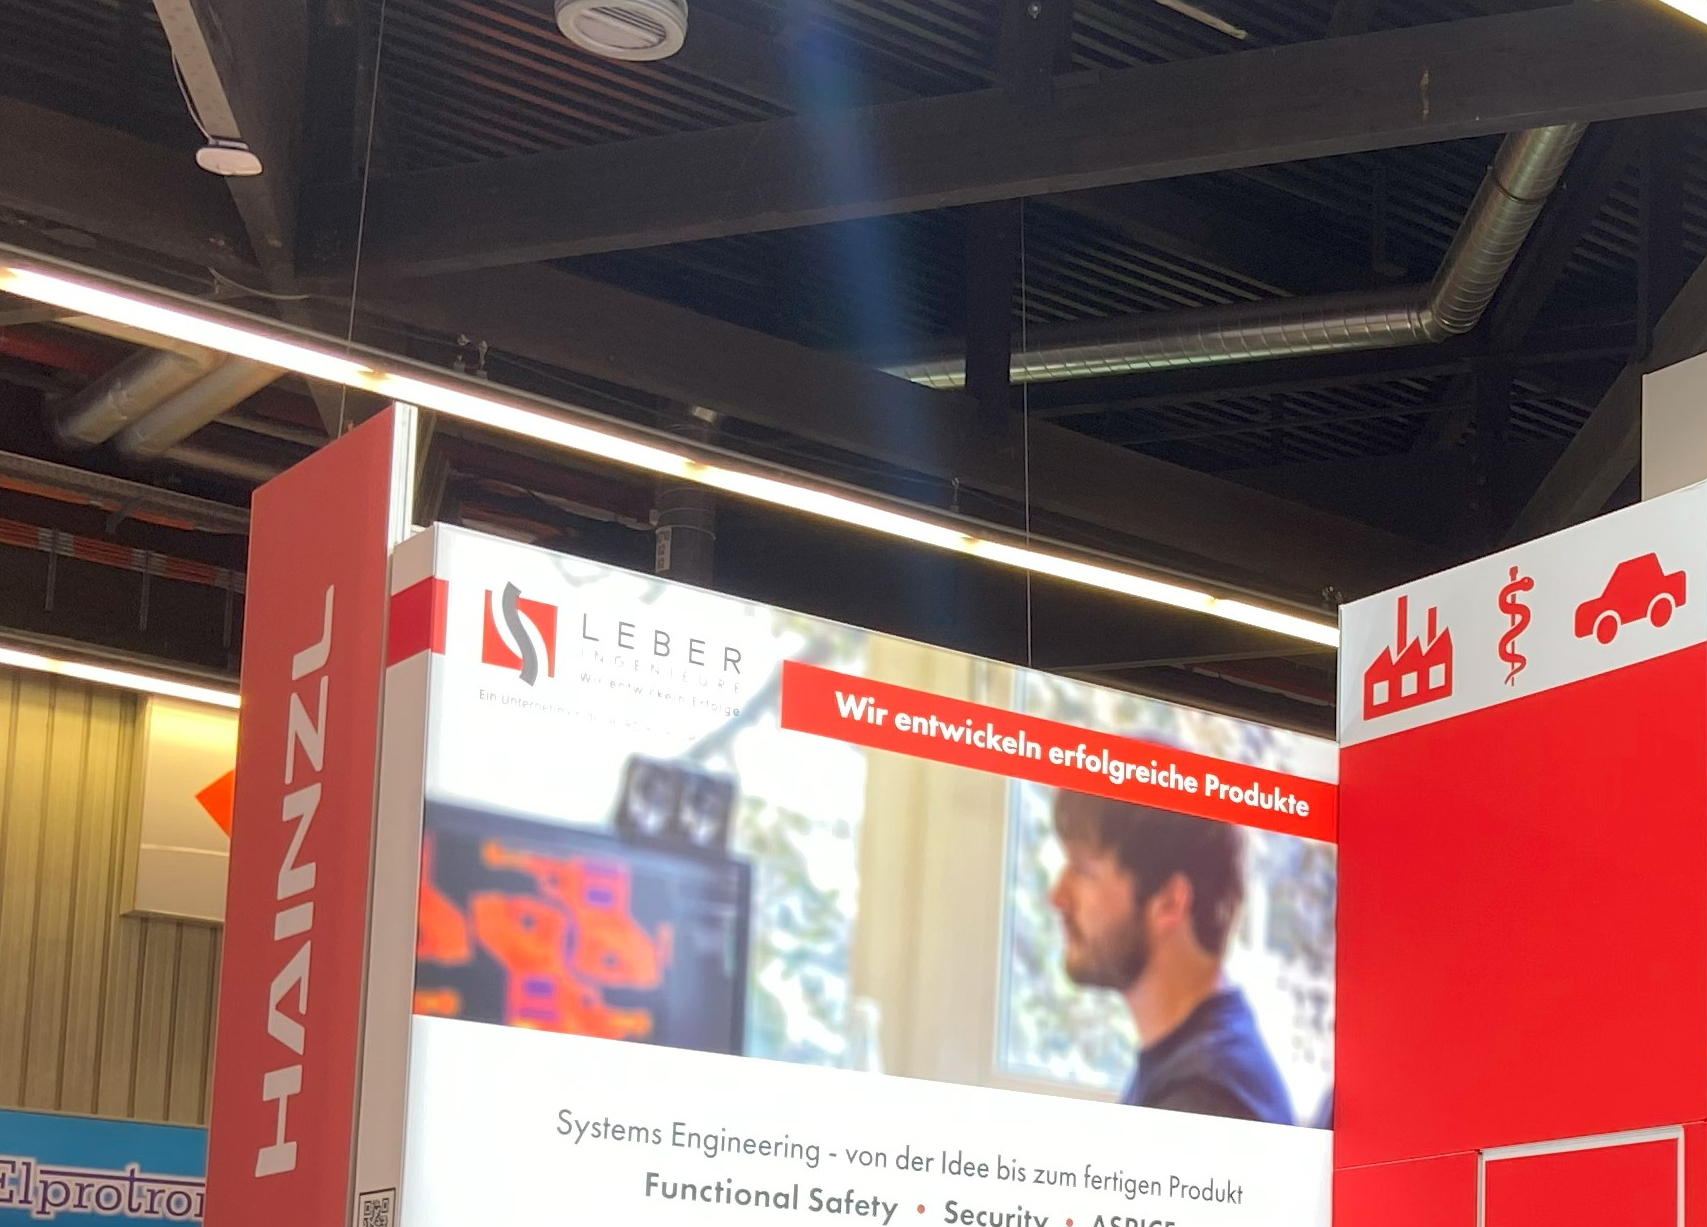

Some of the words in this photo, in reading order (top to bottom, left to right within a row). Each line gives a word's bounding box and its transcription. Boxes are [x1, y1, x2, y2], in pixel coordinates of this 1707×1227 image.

[582, 612, 742, 674] LEBER
[835, 690, 889, 726] Wir
[894, 711, 1042, 760] entwickeln
[1048, 743, 1198, 793] erfolgreiche
[1204, 773, 1310, 817] Produkte
[255, 584, 335, 1178] HAINZL
[556, 1108, 662, 1145] Systems
[671, 1121, 820, 1168] Engineering
[845, 1148, 887, 1168] von
[895, 1144, 934, 1173] der
[941, 1150, 990, 1178] Idee
[997, 1154, 1027, 1183] bis
[1032, 1168, 1077, 1188] zum
[1084, 1163, 1162, 1200] fertigen
[1169, 1174, 1244, 1205] Produkt
[645, 1171, 799, 1210] Functional
[808, 1187, 899, 1226] Safety
